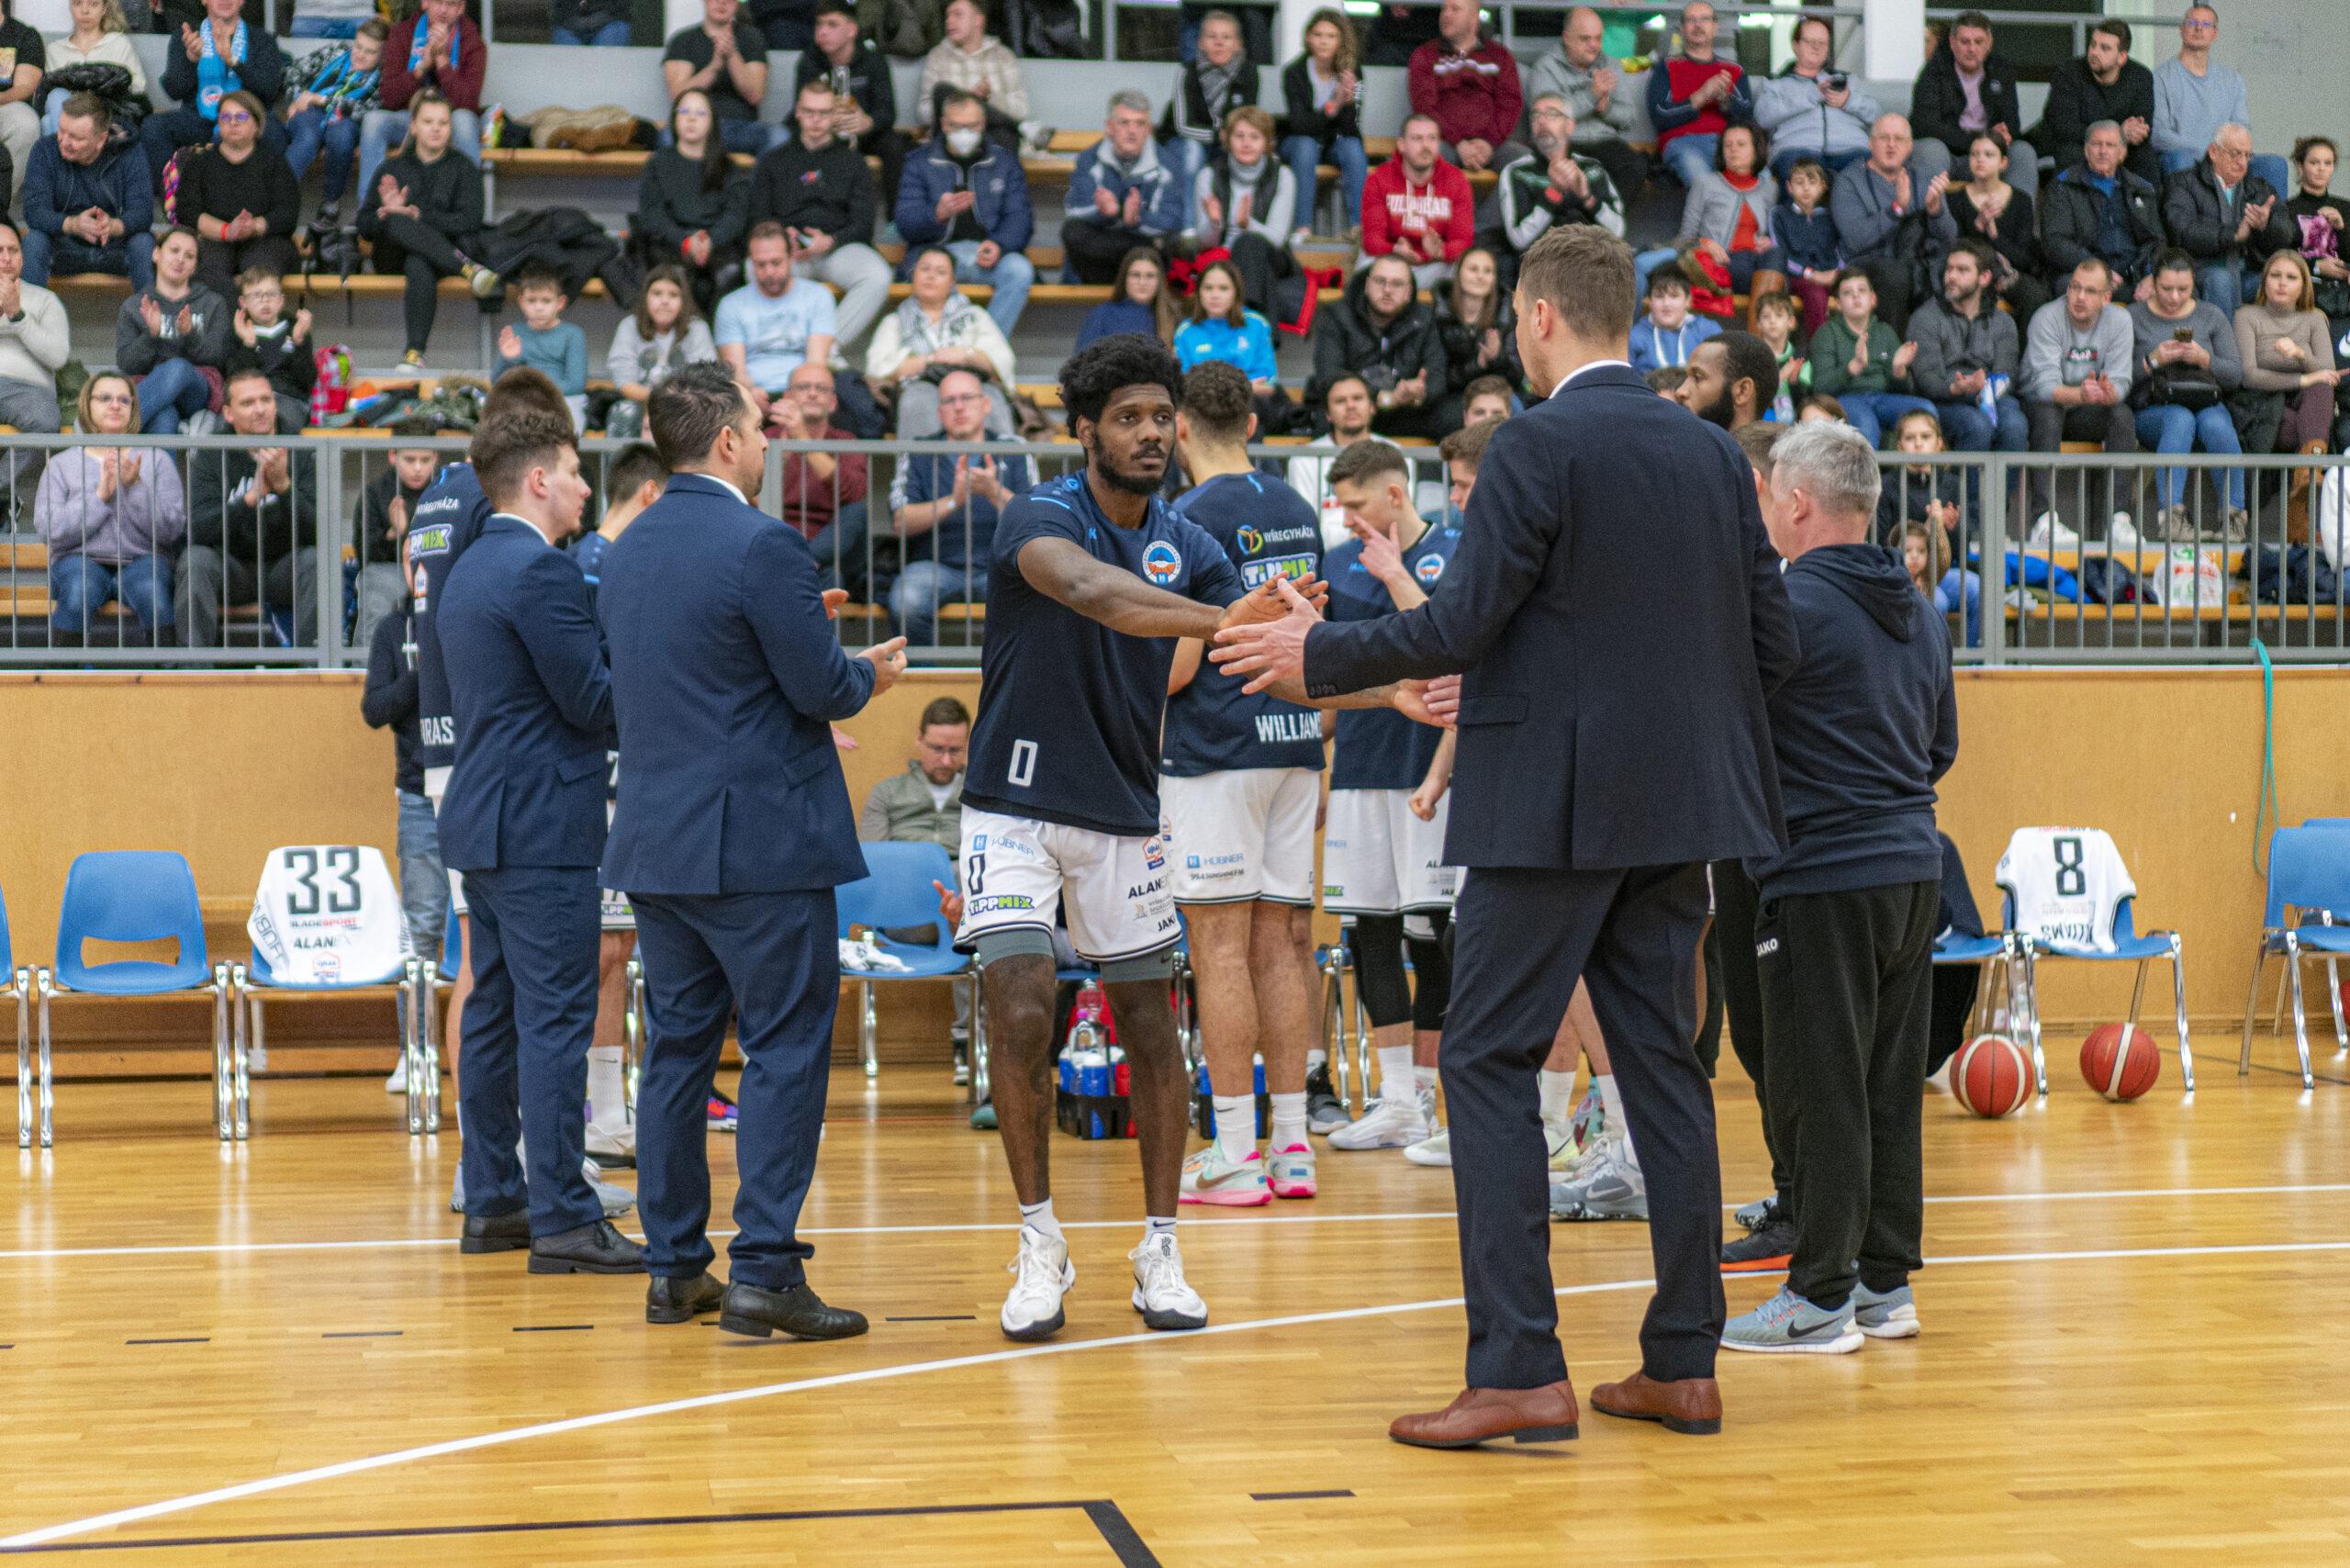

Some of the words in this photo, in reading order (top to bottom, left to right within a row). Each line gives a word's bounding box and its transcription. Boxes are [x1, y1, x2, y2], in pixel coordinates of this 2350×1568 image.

[1255, 711, 1322, 743] WILLIAM
[1008, 739, 1038, 787] 0
[284, 846, 362, 914] 33
[2053, 837, 2086, 895] 8
[1158, 914, 1176, 933] JAK
